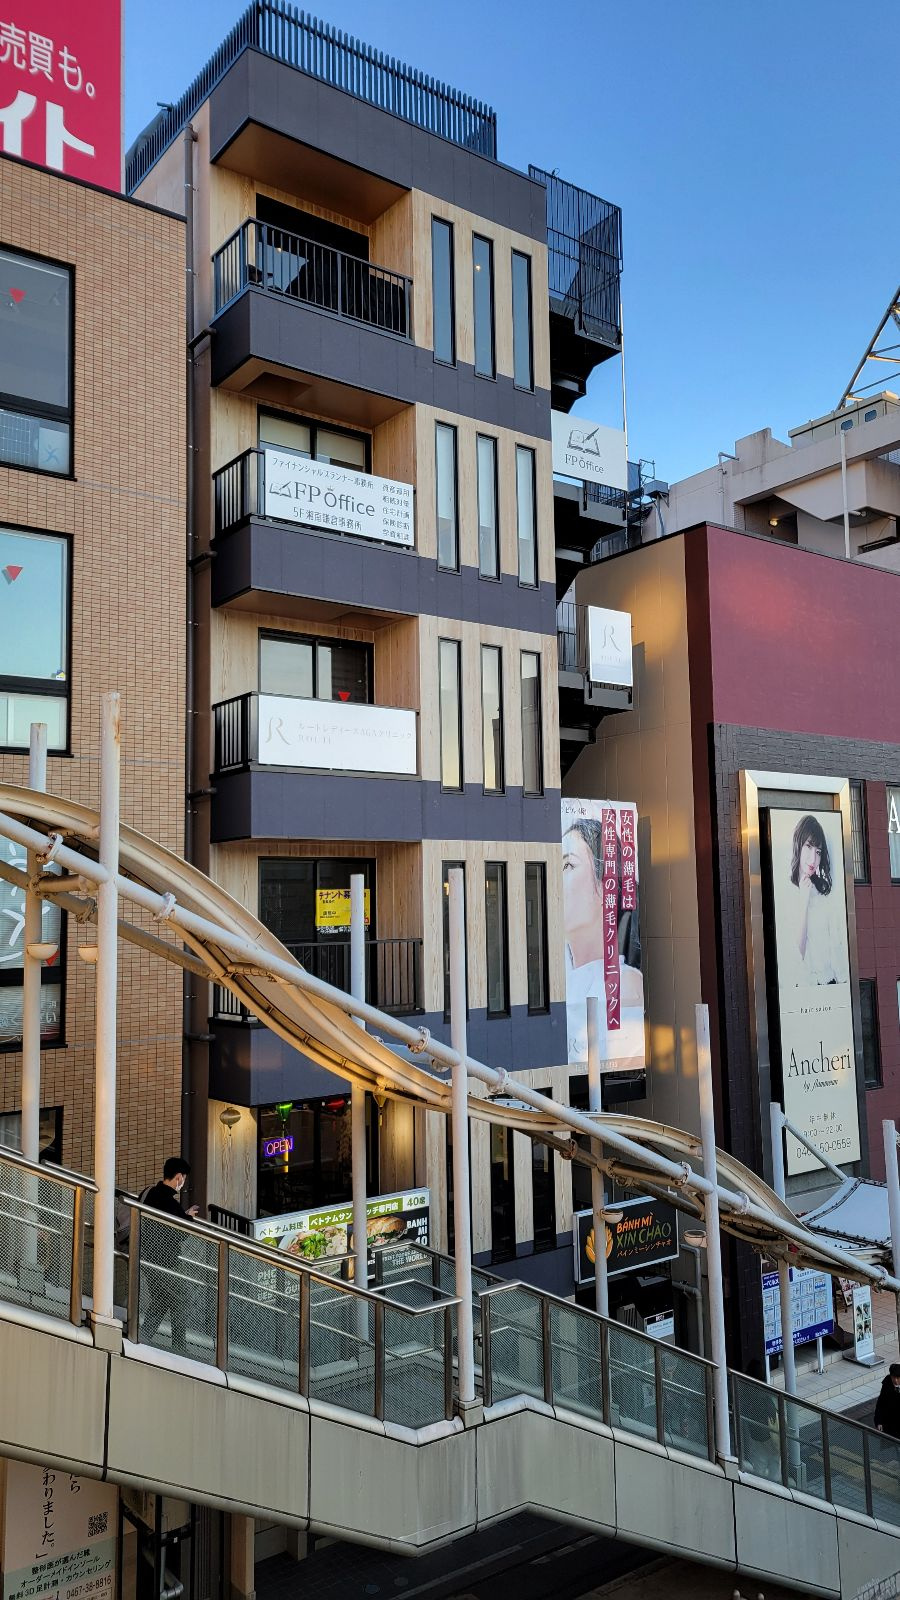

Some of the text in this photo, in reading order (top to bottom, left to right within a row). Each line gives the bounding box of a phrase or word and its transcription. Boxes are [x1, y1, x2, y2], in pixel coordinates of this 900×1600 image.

[564, 453, 605, 475] FP Office
[294, 481, 376, 517] FP Office
[621, 811, 635, 909] 女性の薄毛は
[604, 809, 620, 1025] 女性専門の薄毛クリニックへ
[788, 1041, 852, 1077] Ancheri
[267, 1138, 293, 1155] OPEN
[407, 1217, 427, 1229] BANH
[616, 1220, 672, 1249] XIN CHÀO
[20, 1556, 101, 1588] オーダーメイドインソール
